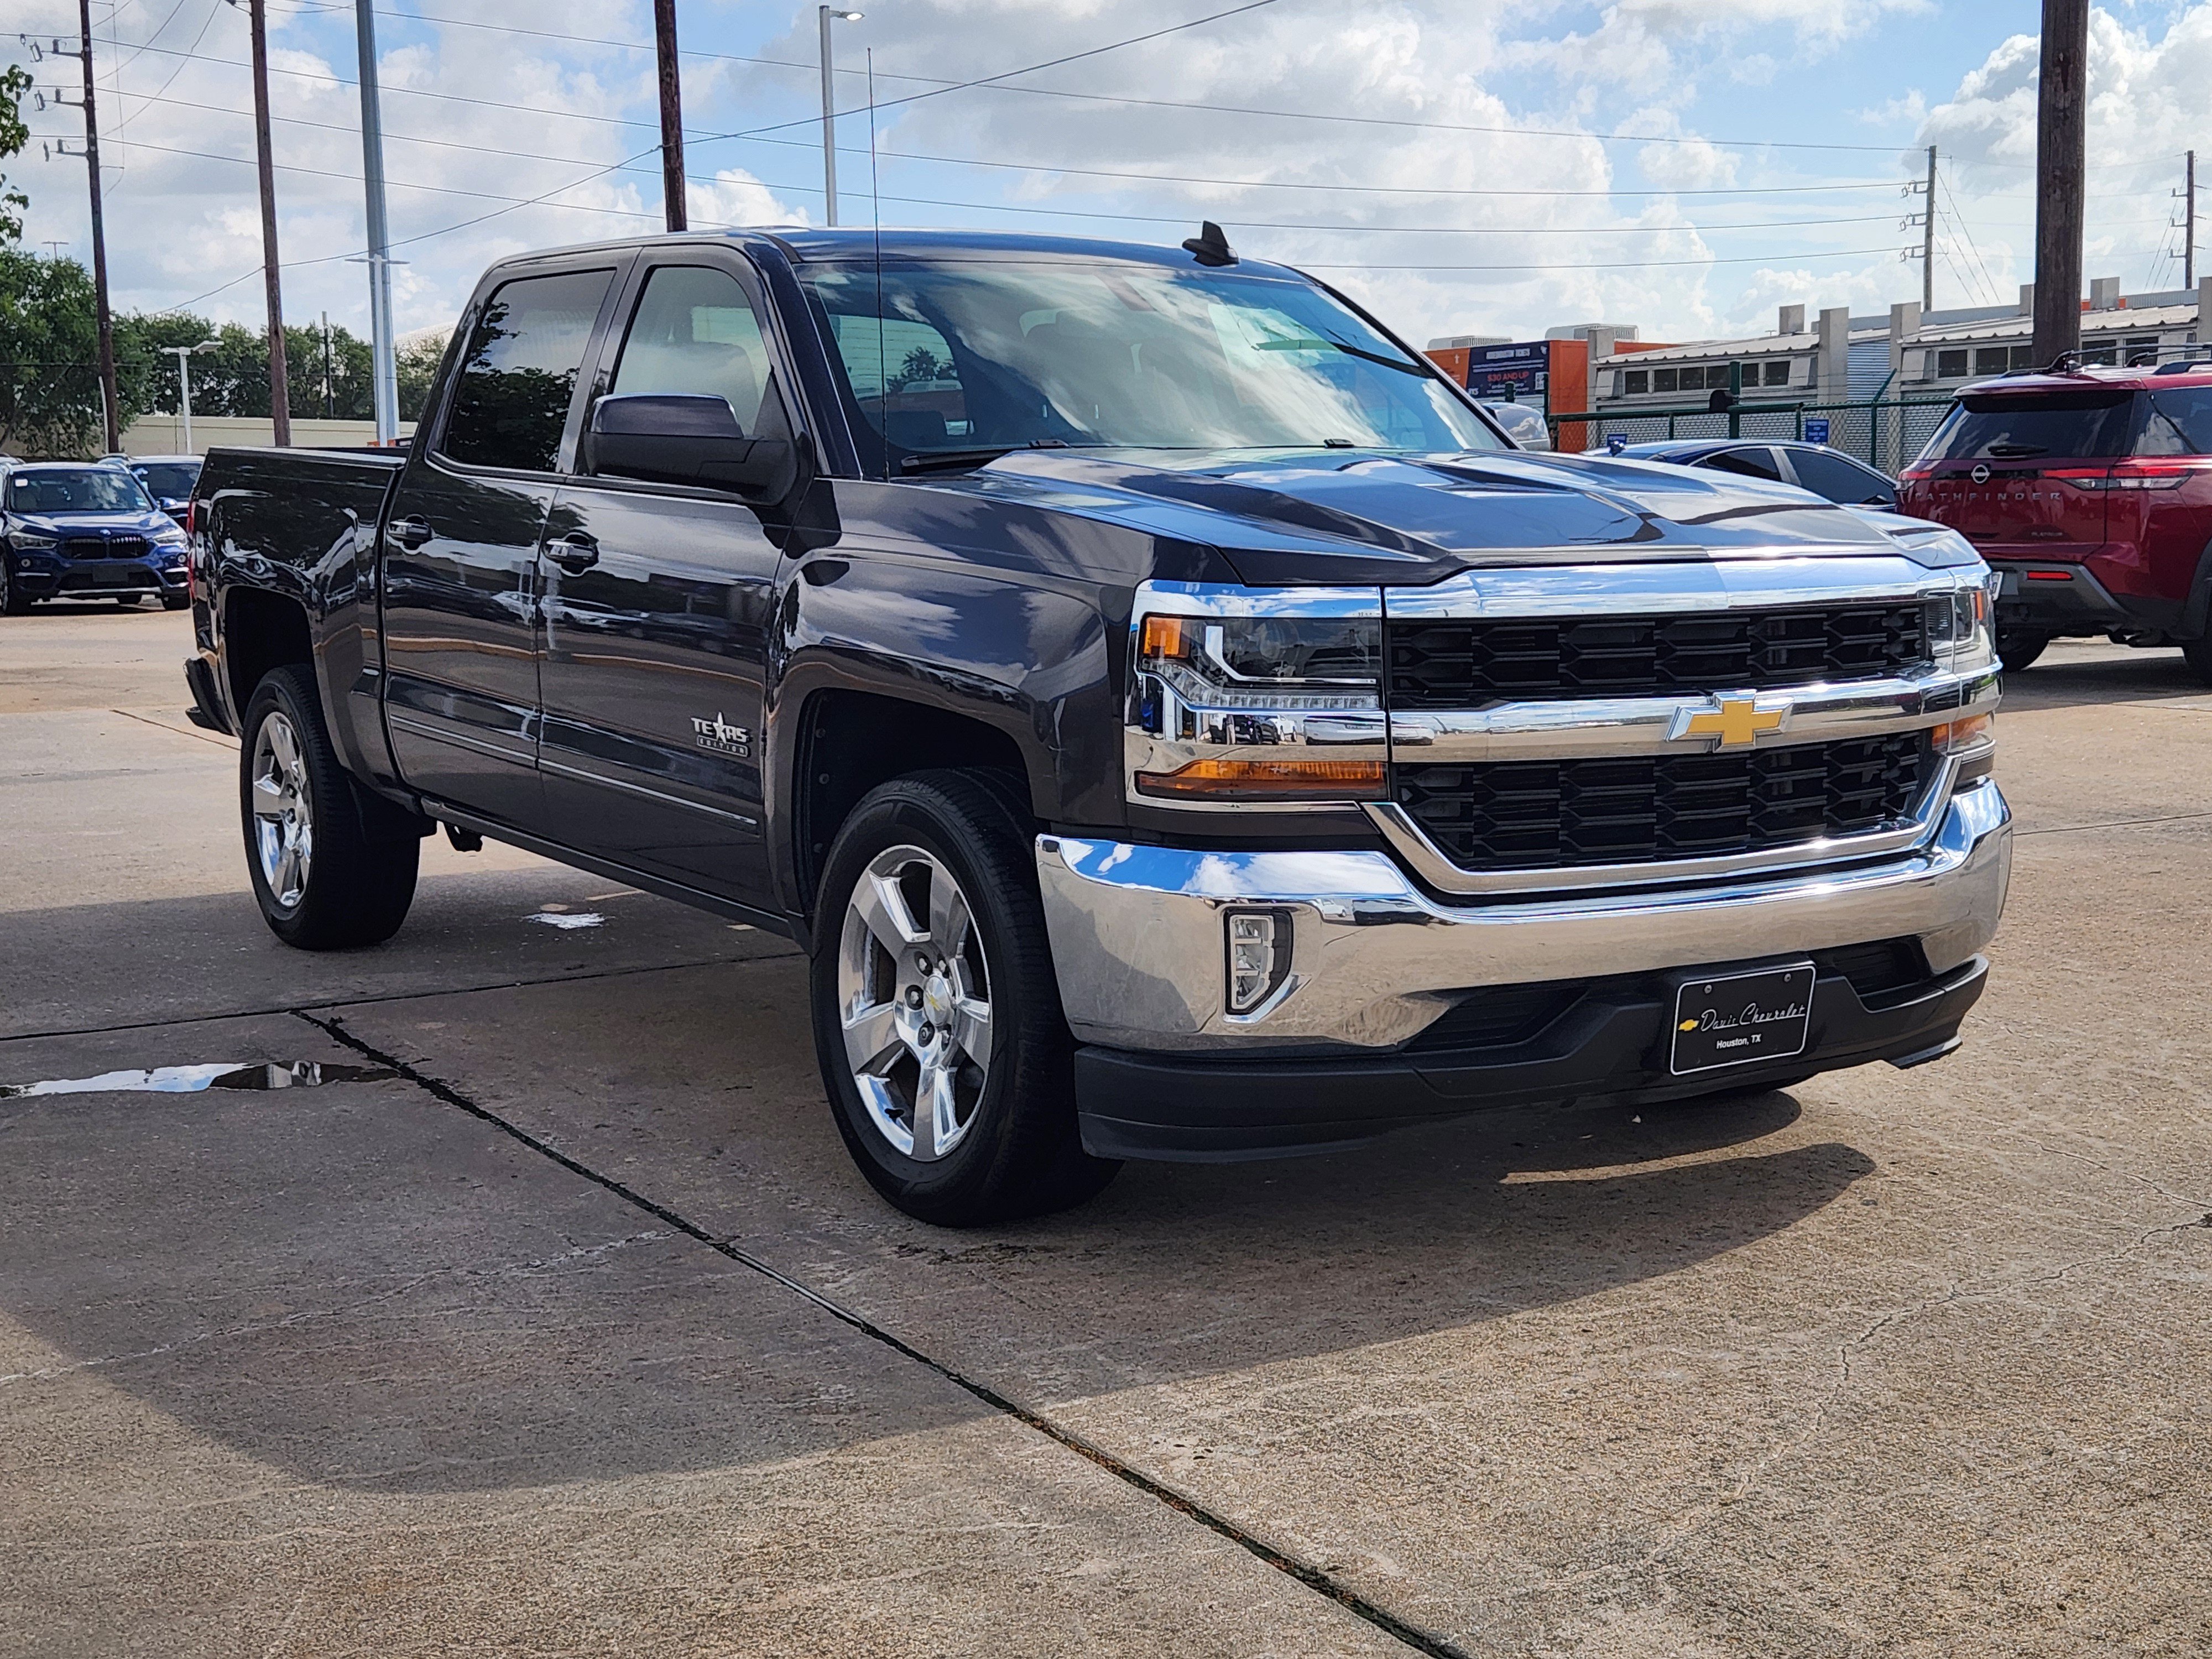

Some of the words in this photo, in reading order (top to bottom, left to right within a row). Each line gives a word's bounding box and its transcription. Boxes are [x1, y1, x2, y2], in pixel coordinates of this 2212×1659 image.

[1487, 374, 1501, 382] $30
[1503, 372, 1517, 380] AND
[1518, 371, 1530, 379] UP
[1915, 492, 2061, 500] PATHFINDER
[691, 711, 747, 744] TEXAS
[1700, 1009, 1739, 1032] Davis
[1739, 1003, 1806, 1025] Chevrolet
[1716, 1038, 1749, 1050] Houston,
[1751, 1034, 1762, 1044] TX
